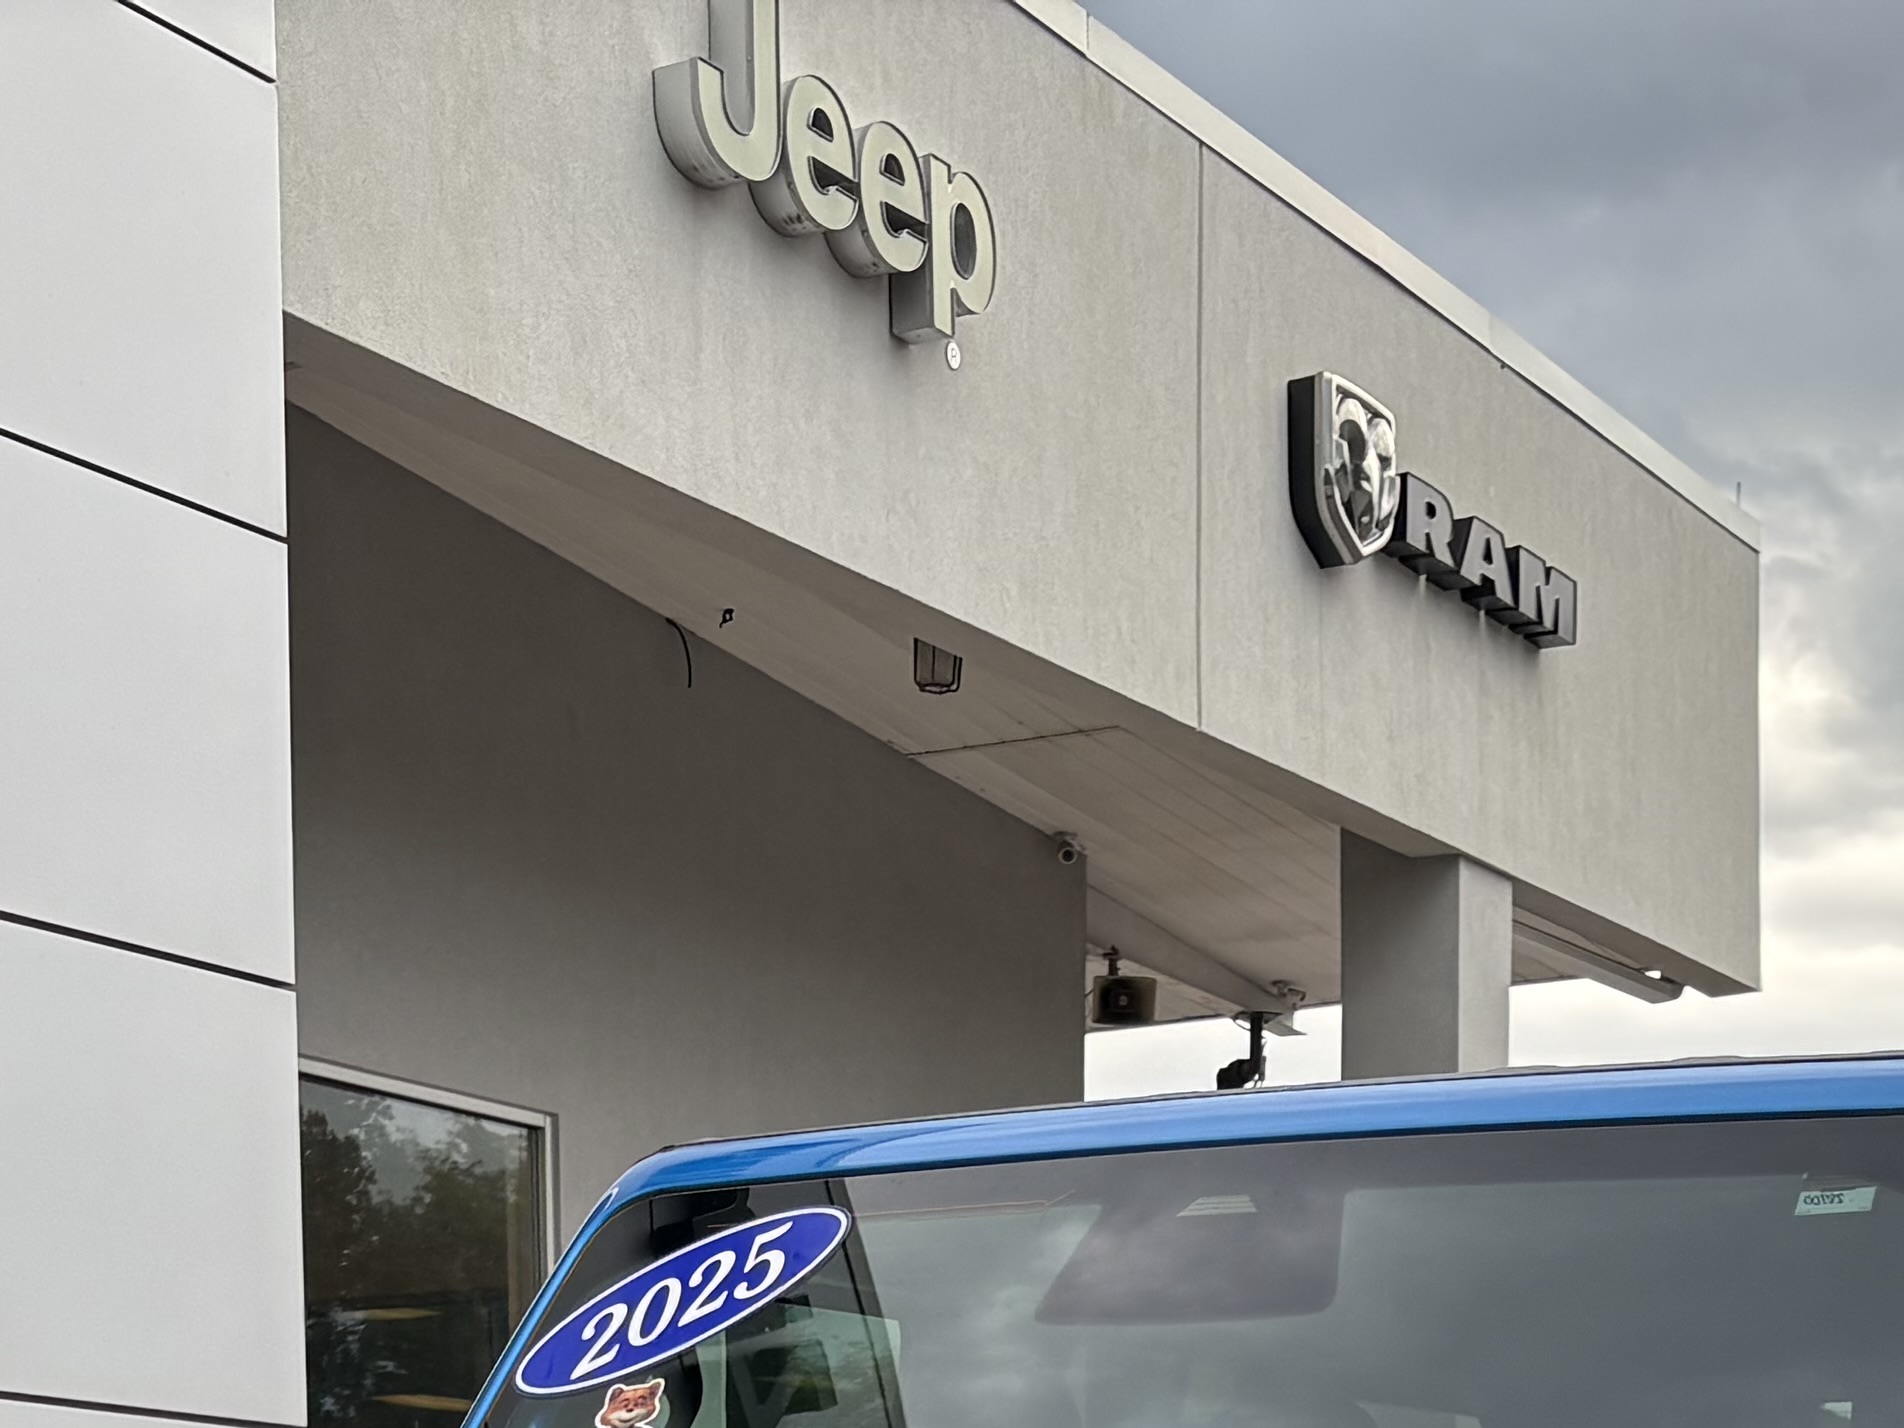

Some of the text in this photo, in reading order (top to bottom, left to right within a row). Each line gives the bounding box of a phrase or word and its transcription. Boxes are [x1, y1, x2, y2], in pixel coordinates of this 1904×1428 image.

[652, 0, 997, 342] Jeep
[1399, 471, 1578, 649] RAM
[570, 1221, 794, 1380] 2025
